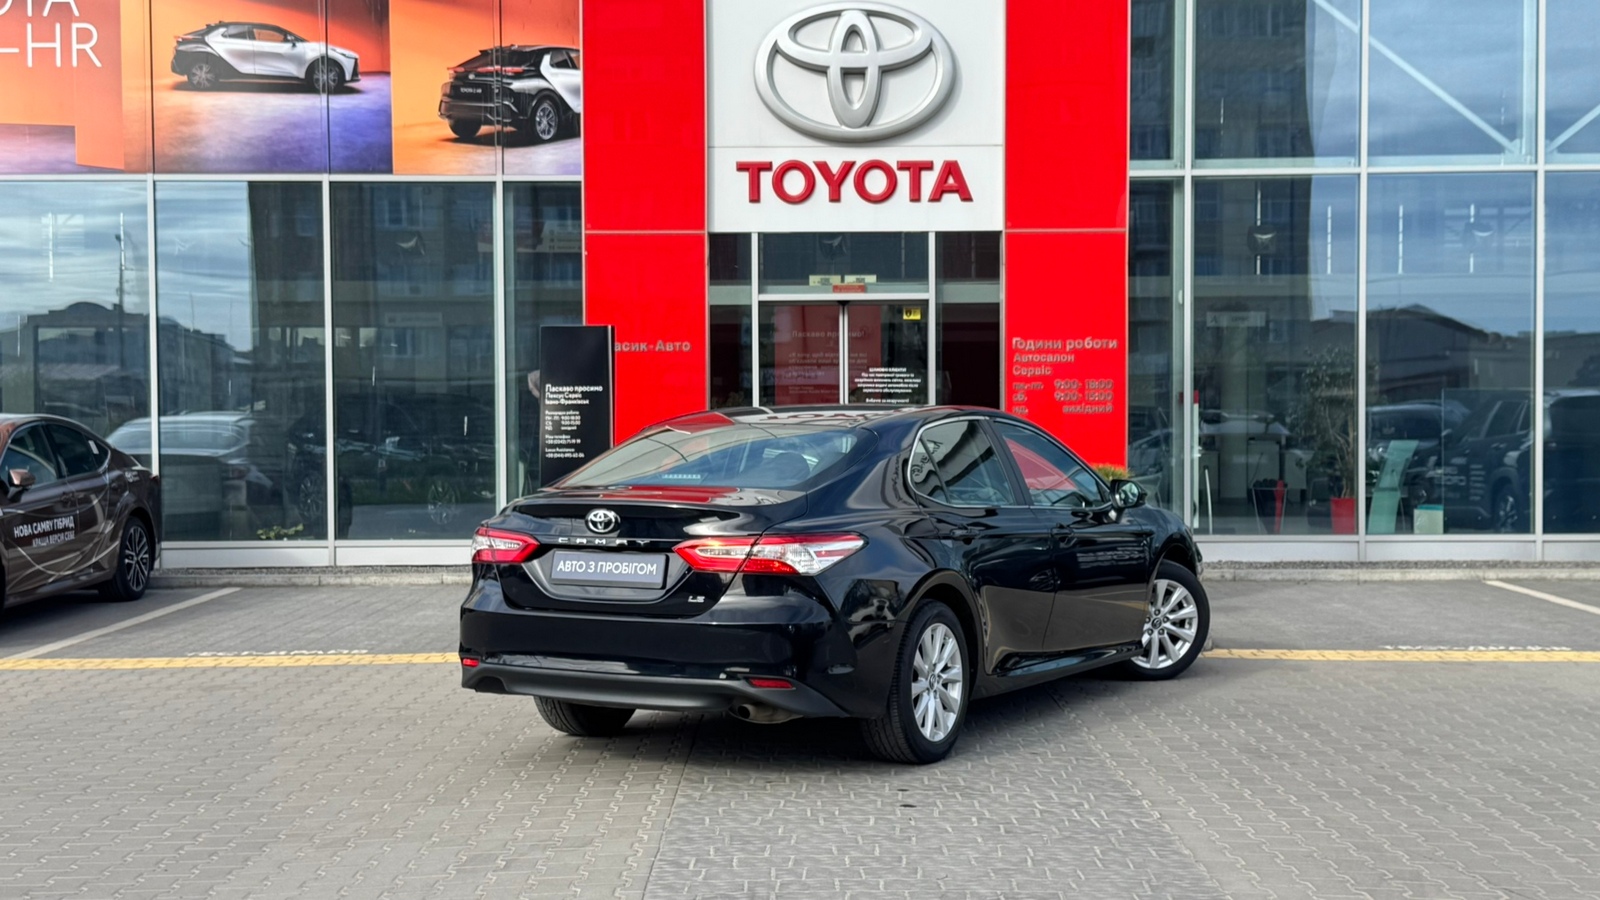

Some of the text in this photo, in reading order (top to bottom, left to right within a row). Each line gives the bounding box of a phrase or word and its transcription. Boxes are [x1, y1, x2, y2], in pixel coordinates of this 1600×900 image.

[736, 159, 974, 204] TOYOTA
[1012, 336, 1118, 352] Години роботи
[1013, 353, 1075, 362] Автосалон
[1012, 365, 1053, 377] Сервіс
[14, 515, 75, 538] НОВА CAMRY ГІБРИД
[558, 537, 650, 546] CAMRY
[557, 560, 586, 573] АВТО
[597, 561, 657, 575] ПРОБІГОМ
